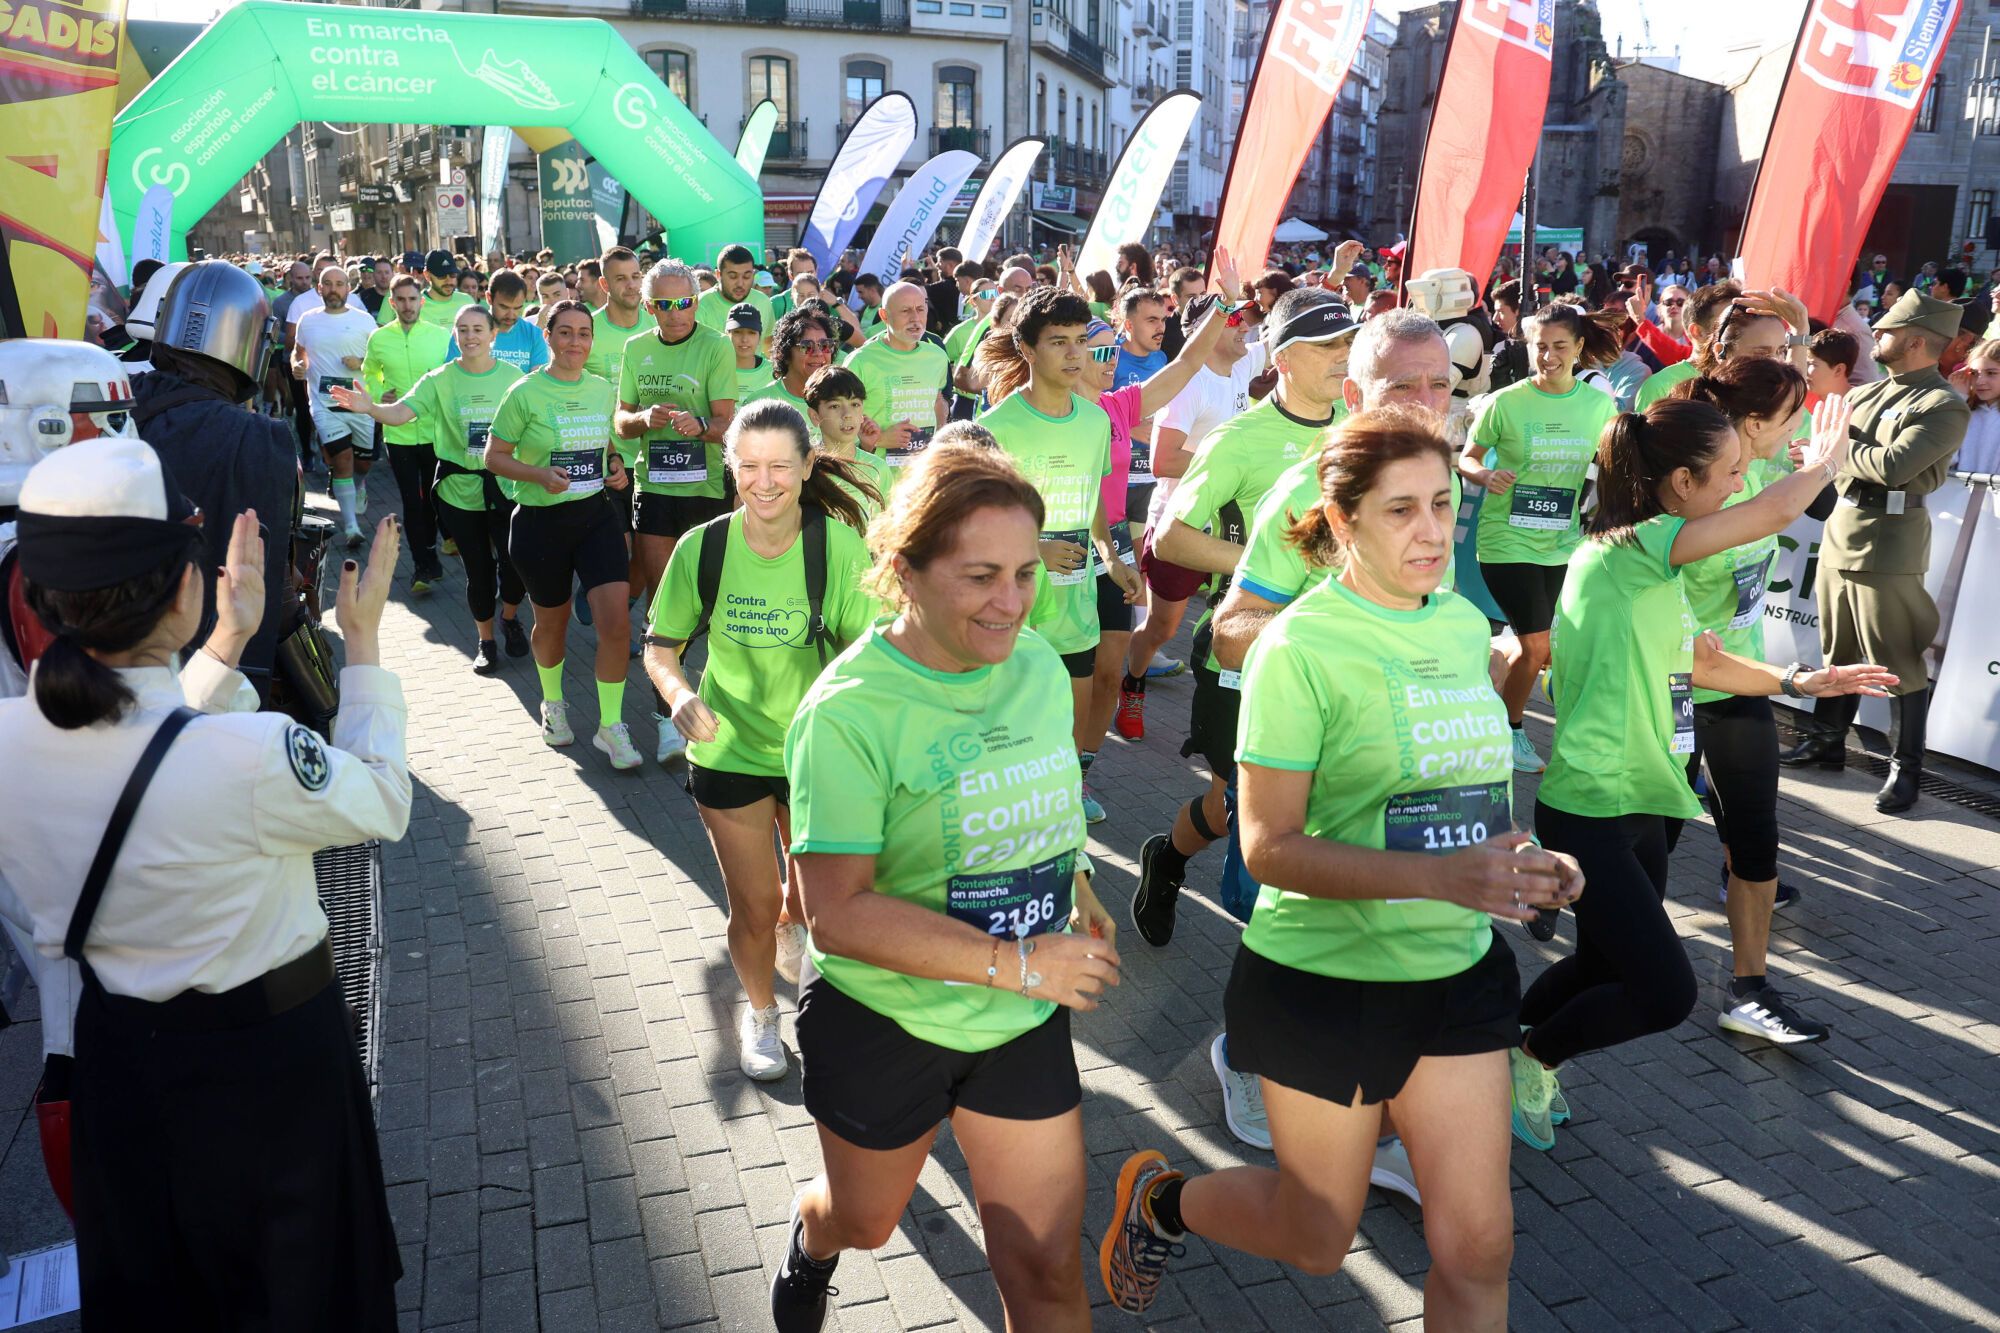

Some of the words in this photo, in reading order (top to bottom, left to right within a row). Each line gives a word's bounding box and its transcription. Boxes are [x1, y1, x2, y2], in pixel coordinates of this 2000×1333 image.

[306, 17, 342, 39] En
[348, 23, 451, 43] marcha
[310, 44, 400, 66] contra
[312, 69, 339, 91] el
[344, 70, 437, 94] cáncer
[170, 87, 227, 144] asociación
[183, 106, 233, 155] española
[196, 133, 232, 166] contra
[230, 121, 243, 134] el
[240, 86, 276, 124] cáncer
[653, 124, 695, 168] española
[661, 115, 709, 164] asociación
[644, 134, 675, 166] contra
[673, 162, 685, 176] el
[682, 172, 715, 205] cáncer
[1101, 122, 1159, 245] caser
[638, 374, 672, 386] PONTE
[639, 388, 671, 397] CORRER
[556, 415, 570, 424] En
[560, 426, 600, 438] contra
[1531, 436, 1546, 447] En
[662, 453, 692, 466] 1567
[1531, 448, 1580, 461] contra
[566, 463, 594, 476] 2395
[1043, 489, 1083, 505] ontra
[1527, 499, 1559, 512] 1559
[726, 594, 767, 607] Contra
[726, 608, 738, 619] el
[739, 609, 780, 621] cáncer
[726, 623, 764, 635] somos
[766, 627, 789, 635] uno
[1405, 684, 1438, 708] En
[1412, 710, 1502, 744] contra
[960, 769, 999, 797] En
[926, 742, 961, 874] PONTEVEDRA
[962, 786, 1070, 837] contra
[1388, 807, 1402, 816] en
[1402, 803, 1438, 815] marcha
[1388, 814, 1418, 825] contra
[1419, 814, 1427, 822] o
[1428, 811, 1462, 821] cancro
[964, 813, 1082, 868] cancro
[1423, 821, 1488, 850] 1110
[951, 891, 966, 900] en
[968, 886, 1009, 899] marcha
[952, 876, 1014, 890] Pontevedra
[951, 900, 988, 910] contra
[989, 900, 997, 908] o
[998, 892, 1032, 906] cancro
[988, 892, 1055, 935] 2186
